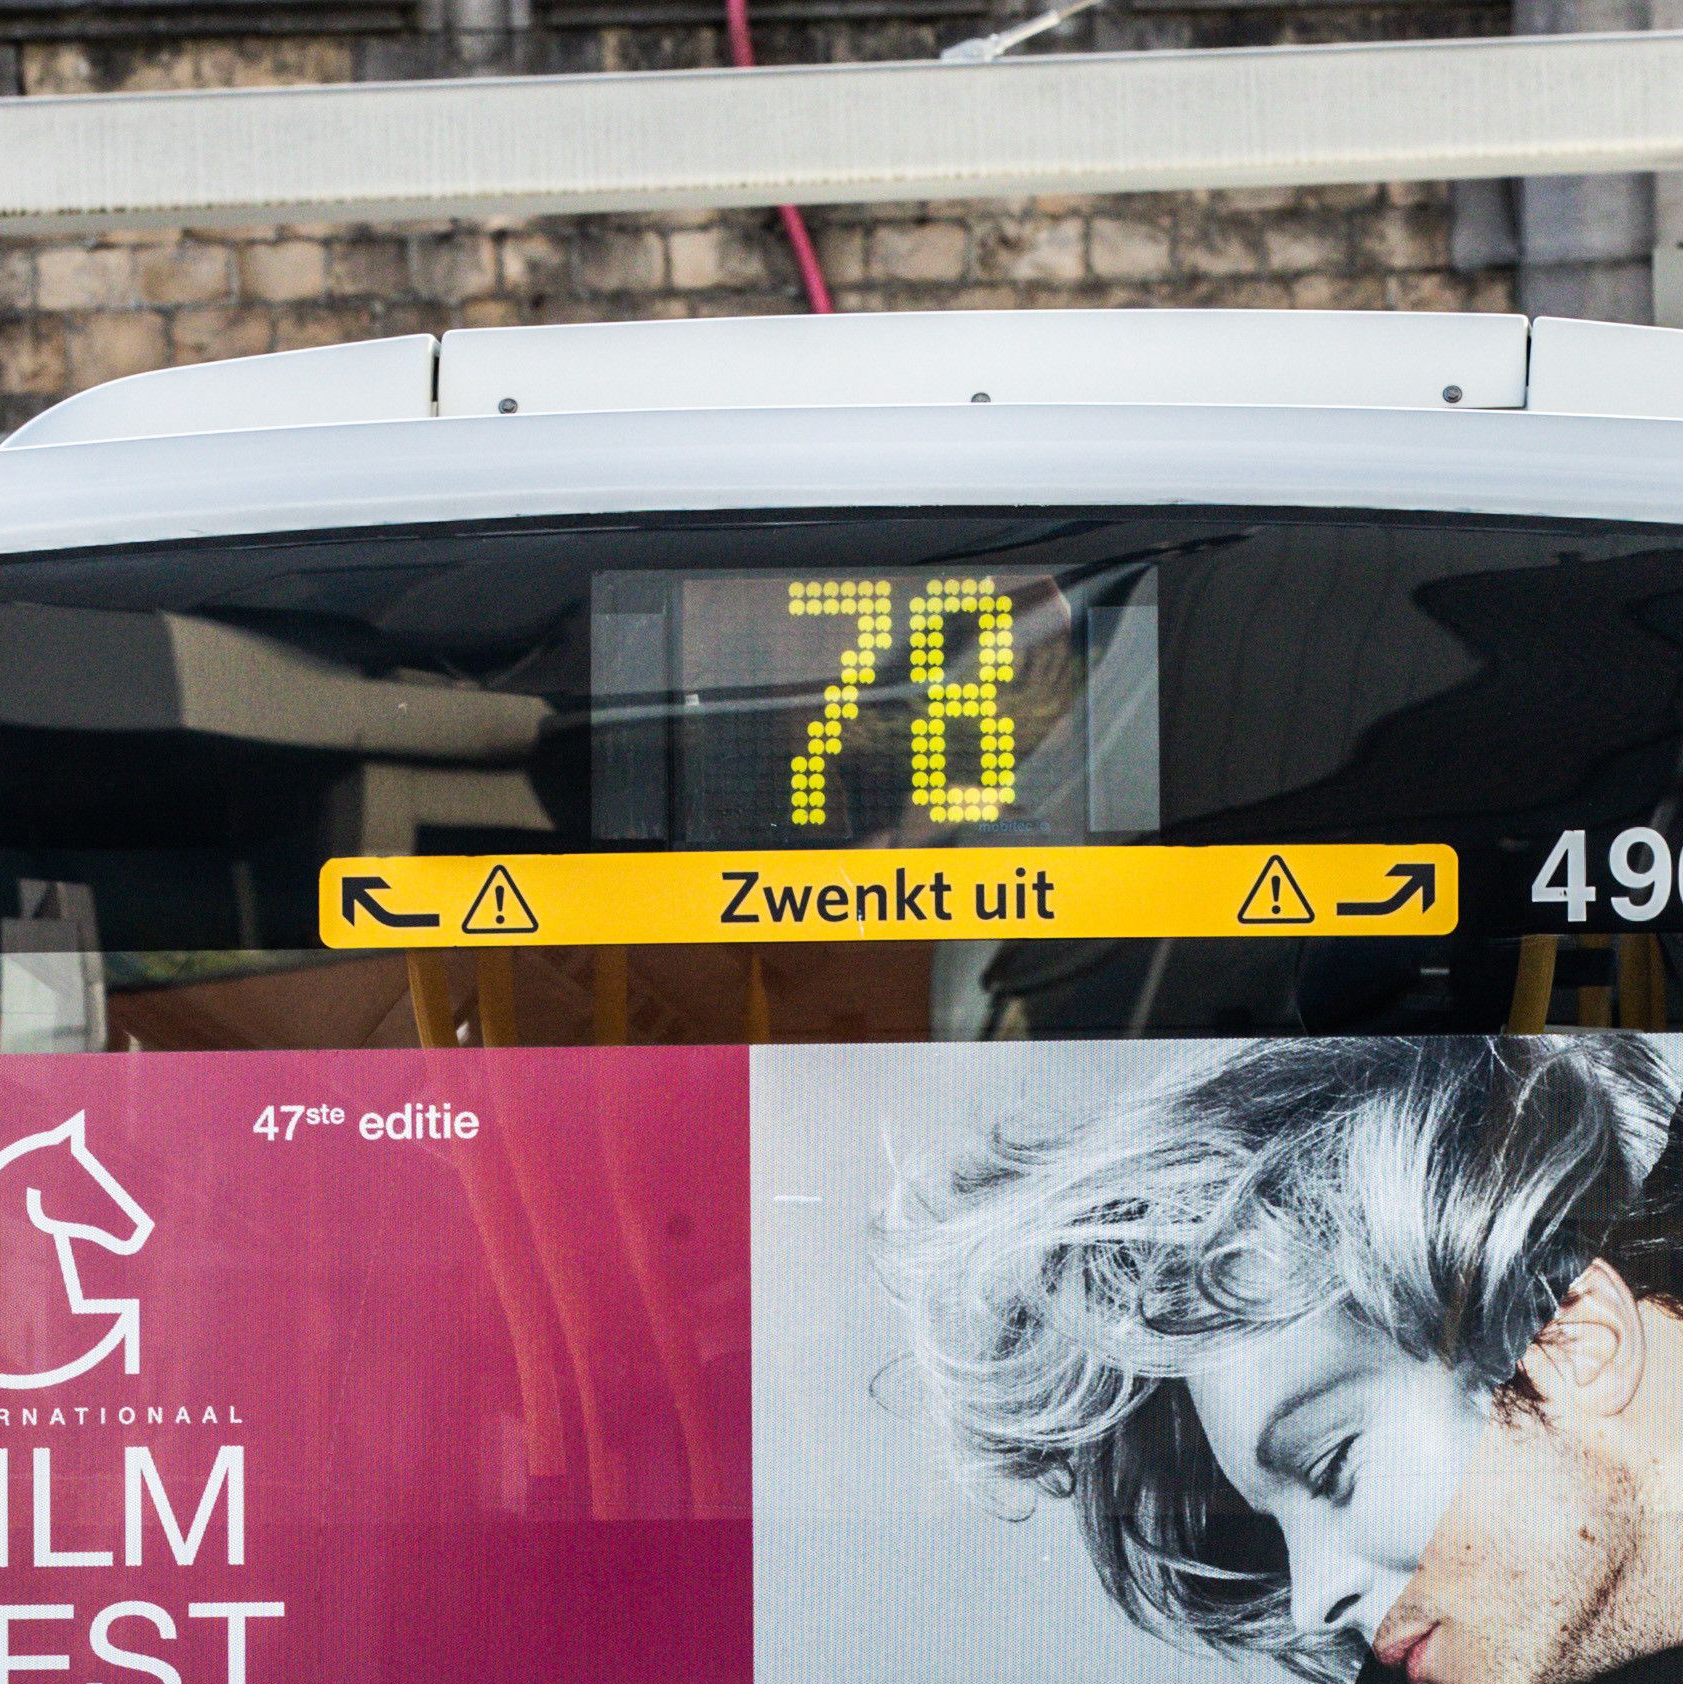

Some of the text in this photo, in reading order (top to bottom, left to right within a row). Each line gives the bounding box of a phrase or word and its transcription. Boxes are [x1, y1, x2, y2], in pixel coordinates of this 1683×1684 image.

[788, 576, 1016, 825] 78
[719, 866, 1056, 928] Zwenkt uit
[252, 1102, 480, 1141] 47ste editie
